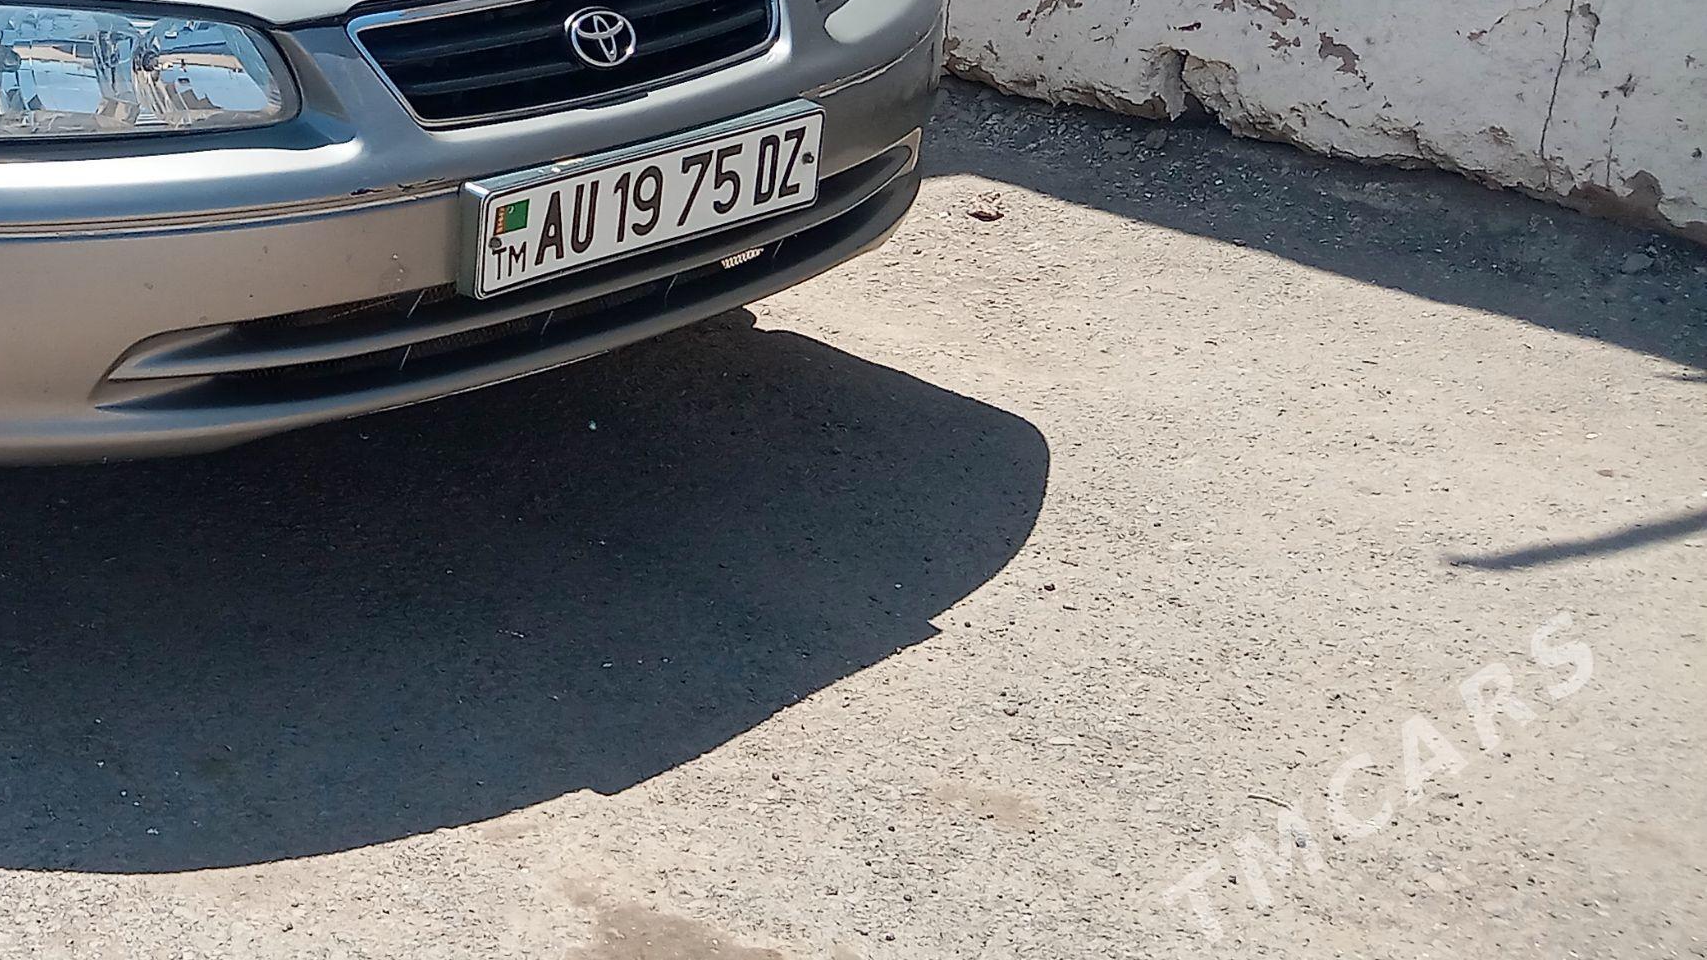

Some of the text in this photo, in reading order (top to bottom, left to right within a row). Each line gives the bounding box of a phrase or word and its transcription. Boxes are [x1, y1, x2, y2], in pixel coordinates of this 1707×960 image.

[534, 126, 807, 266] AU 19 75 DZ
[491, 240, 527, 280] TM
